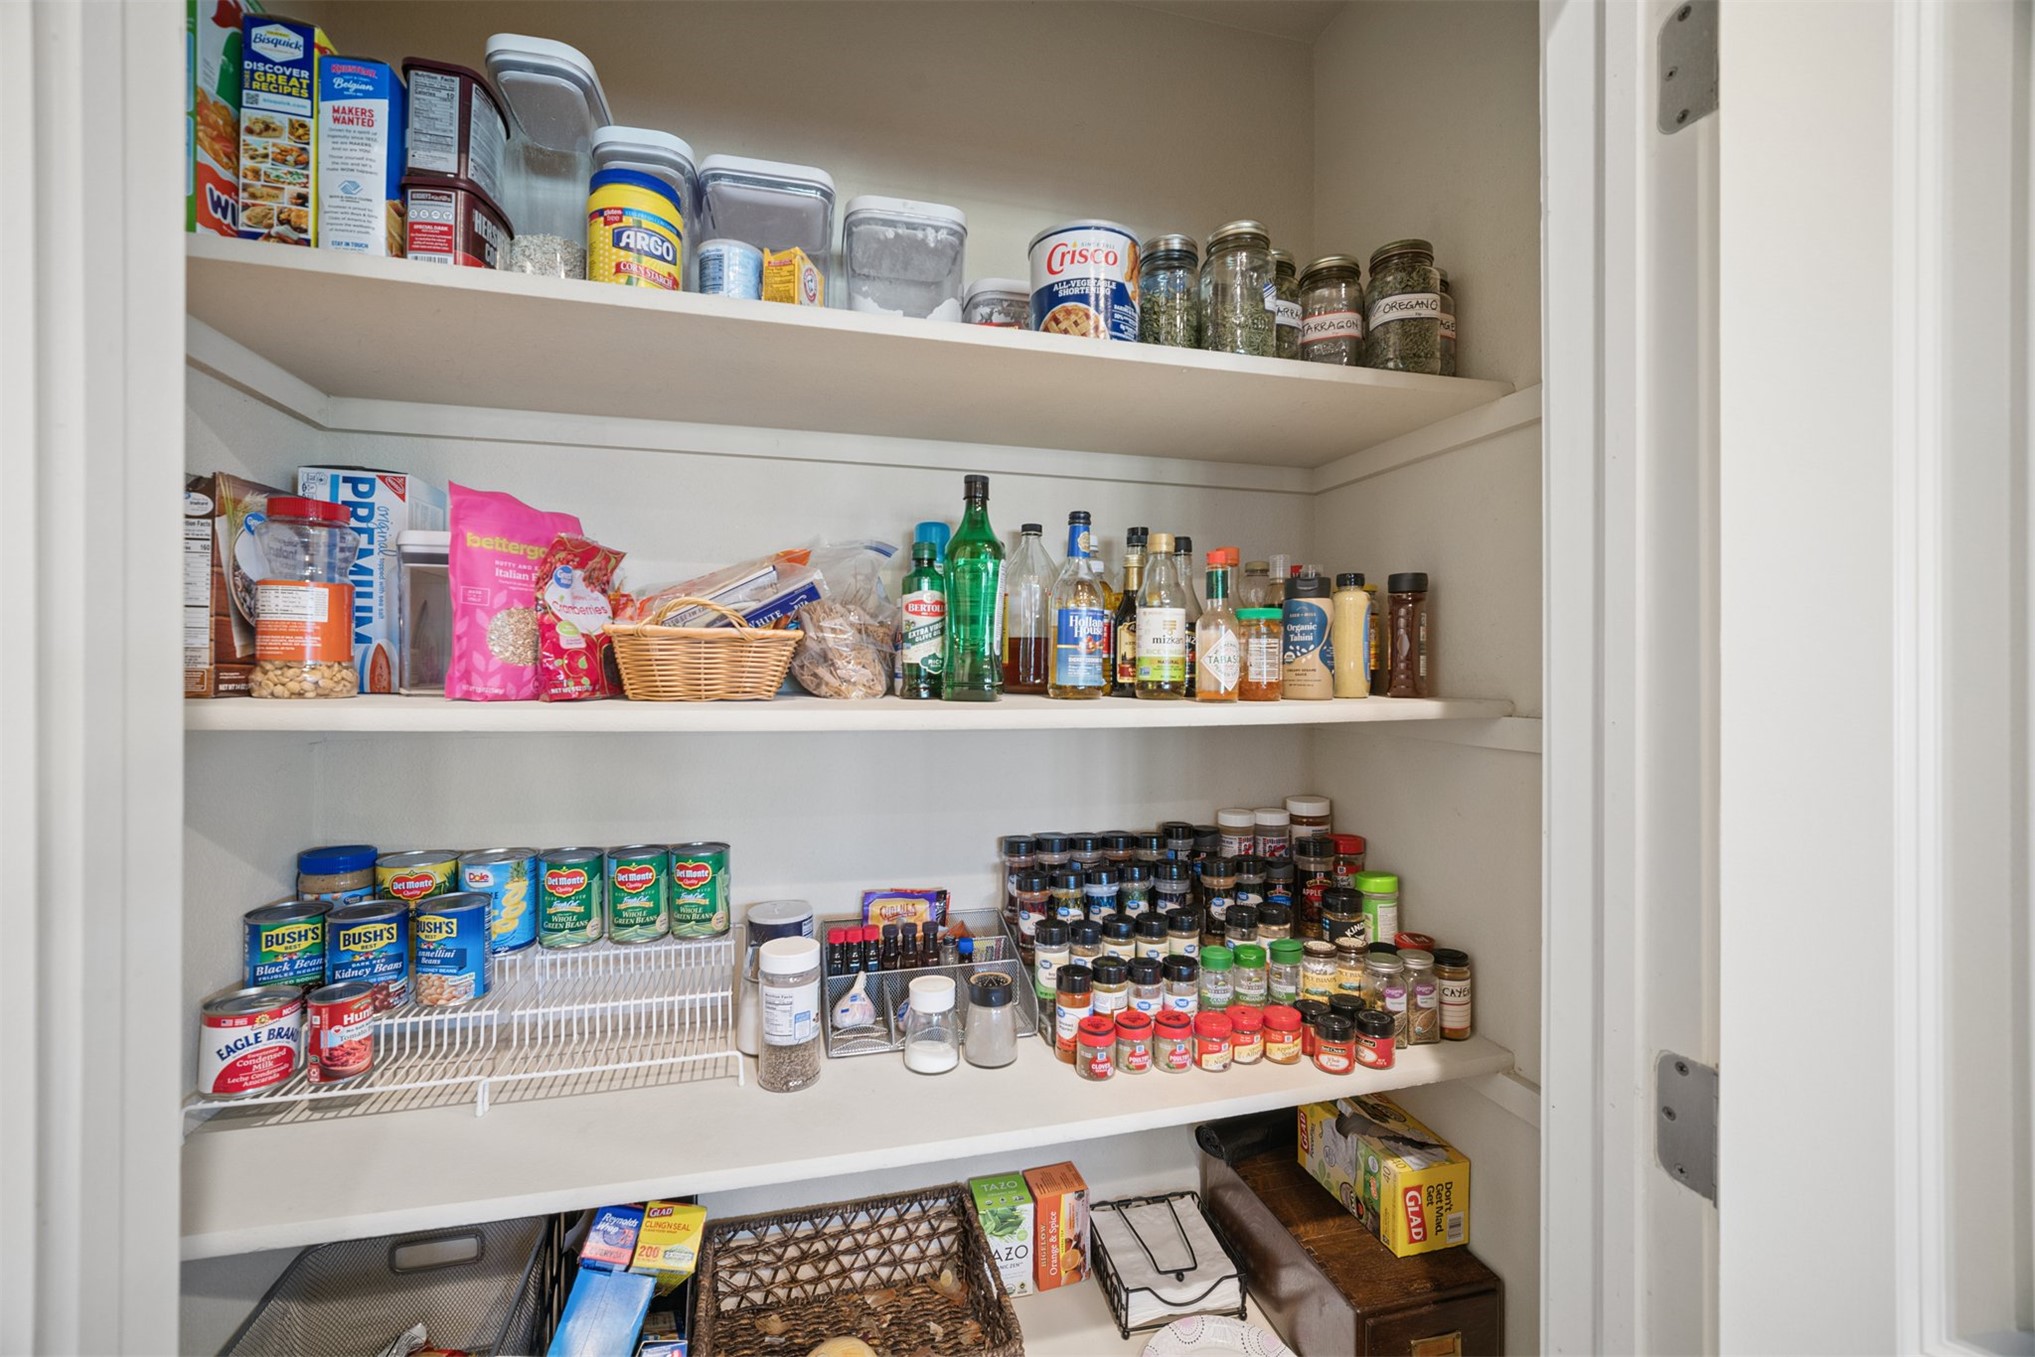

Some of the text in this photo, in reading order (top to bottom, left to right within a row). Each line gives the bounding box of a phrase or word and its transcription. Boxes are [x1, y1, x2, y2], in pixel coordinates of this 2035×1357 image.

[252, 32, 303, 52] Bisquick
[244, 60, 309, 79] DISCOVER
[254, 71, 310, 89] GREAT
[333, 77, 374, 92] Belgian
[252, 81, 309, 98] RECIPES
[332, 105, 374, 118] MAKERS
[332, 115, 374, 128] WANTED
[620, 231, 673, 261] ARGO
[1047, 242, 1118, 275] Crisco
[621, 262, 673, 287] CORN STARCH
[1053, 279, 1116, 291] ALL-VEGETABLE
[1058, 287, 1112, 297] SHORTENING
[1382, 299, 1438, 314] OREGANO
[1302, 320, 1360, 335] TARRAGON
[1440, 320, 1456, 332] AGE
[369, 506, 398, 557] original
[467, 532, 548, 560] bettergo
[342, 475, 377, 645] PREMIUM
[495, 560, 516, 568] NUTTY
[495, 568, 529, 580] Italian
[552, 601, 608, 615] Cranberries
[908, 627, 928, 639] EXTRA
[1287, 623, 1317, 633] Organic
[1289, 633, 1313, 642] Tahini
[468, 872, 489, 882] Dole
[547, 876, 584, 885] Del Monte
[617, 872, 652, 881] Del Monte
[393, 879, 432, 890] Del Monte
[1303, 888, 1322, 896] APPLE
[635, 915, 657, 923] BEANS
[692, 912, 712, 920] BEANS
[544, 920, 589, 929] GREEN BEANS
[265, 926, 319, 948] BUSH'S
[342, 926, 395, 948] BUSH'S
[256, 958, 323, 977] Black Bean
[421, 957, 441, 965] Beans
[334, 961, 402, 980] Kidney Beans
[1442, 987, 1470, 998] CAYE
[216, 1031, 262, 1061] EAGLE
[236, 1048, 286, 1067] Condensed
[252, 1061, 274, 1072] Milk
[227, 1076, 249, 1084] Leche
[1300, 1113, 1309, 1150] GLAD
[982, 1181, 1018, 1192] TAZO
[1445, 1181, 1453, 1212] Don't
[650, 1208, 673, 1217] GLAD
[1406, 1190, 1423, 1240] GLAD
[1435, 1183, 1444, 1236] Get Mad.
[597, 1221, 619, 1234] Wrap
[602, 1213, 639, 1228] Reynolds
[1049, 1211, 1057, 1232] Spice
[638, 1245, 660, 1258] 200
[993, 1245, 1028, 1262] AZO
[1049, 1244, 1058, 1275] Orange
